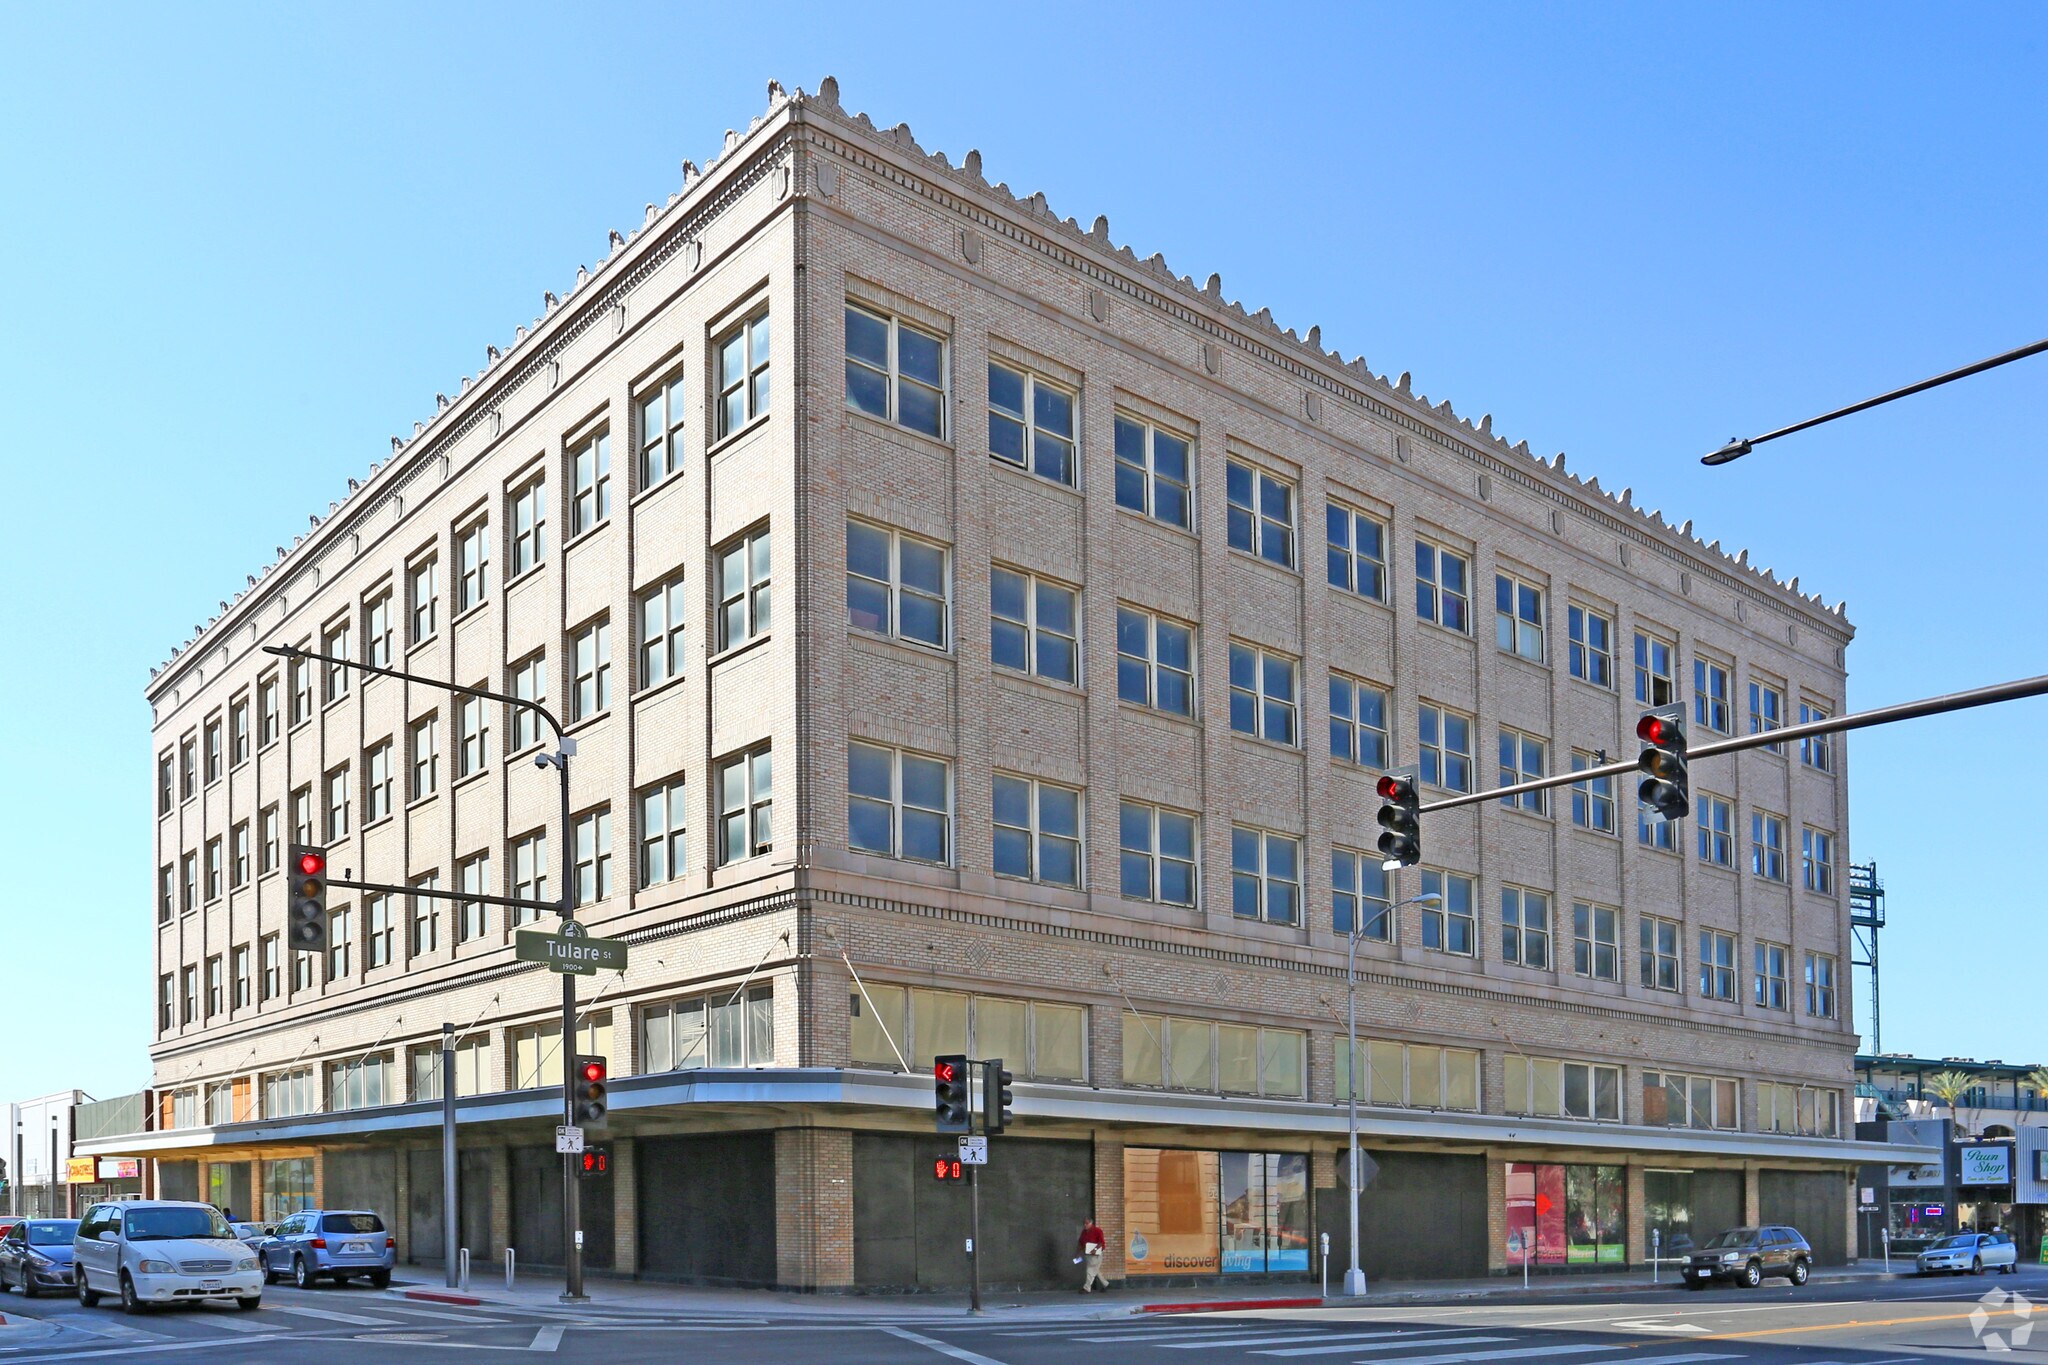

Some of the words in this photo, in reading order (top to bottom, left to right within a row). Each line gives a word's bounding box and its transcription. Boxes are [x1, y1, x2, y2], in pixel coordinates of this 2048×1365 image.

[546, 940, 600, 960] Tulare
[603, 951, 612, 959] St
[562, 963, 578, 971] 1900
[1965, 1149, 1999, 1161] Pawn
[952, 1162, 960, 1178] 0
[1973, 1161, 2005, 1175] Shop
[1163, 1253, 1217, 1268] discover
